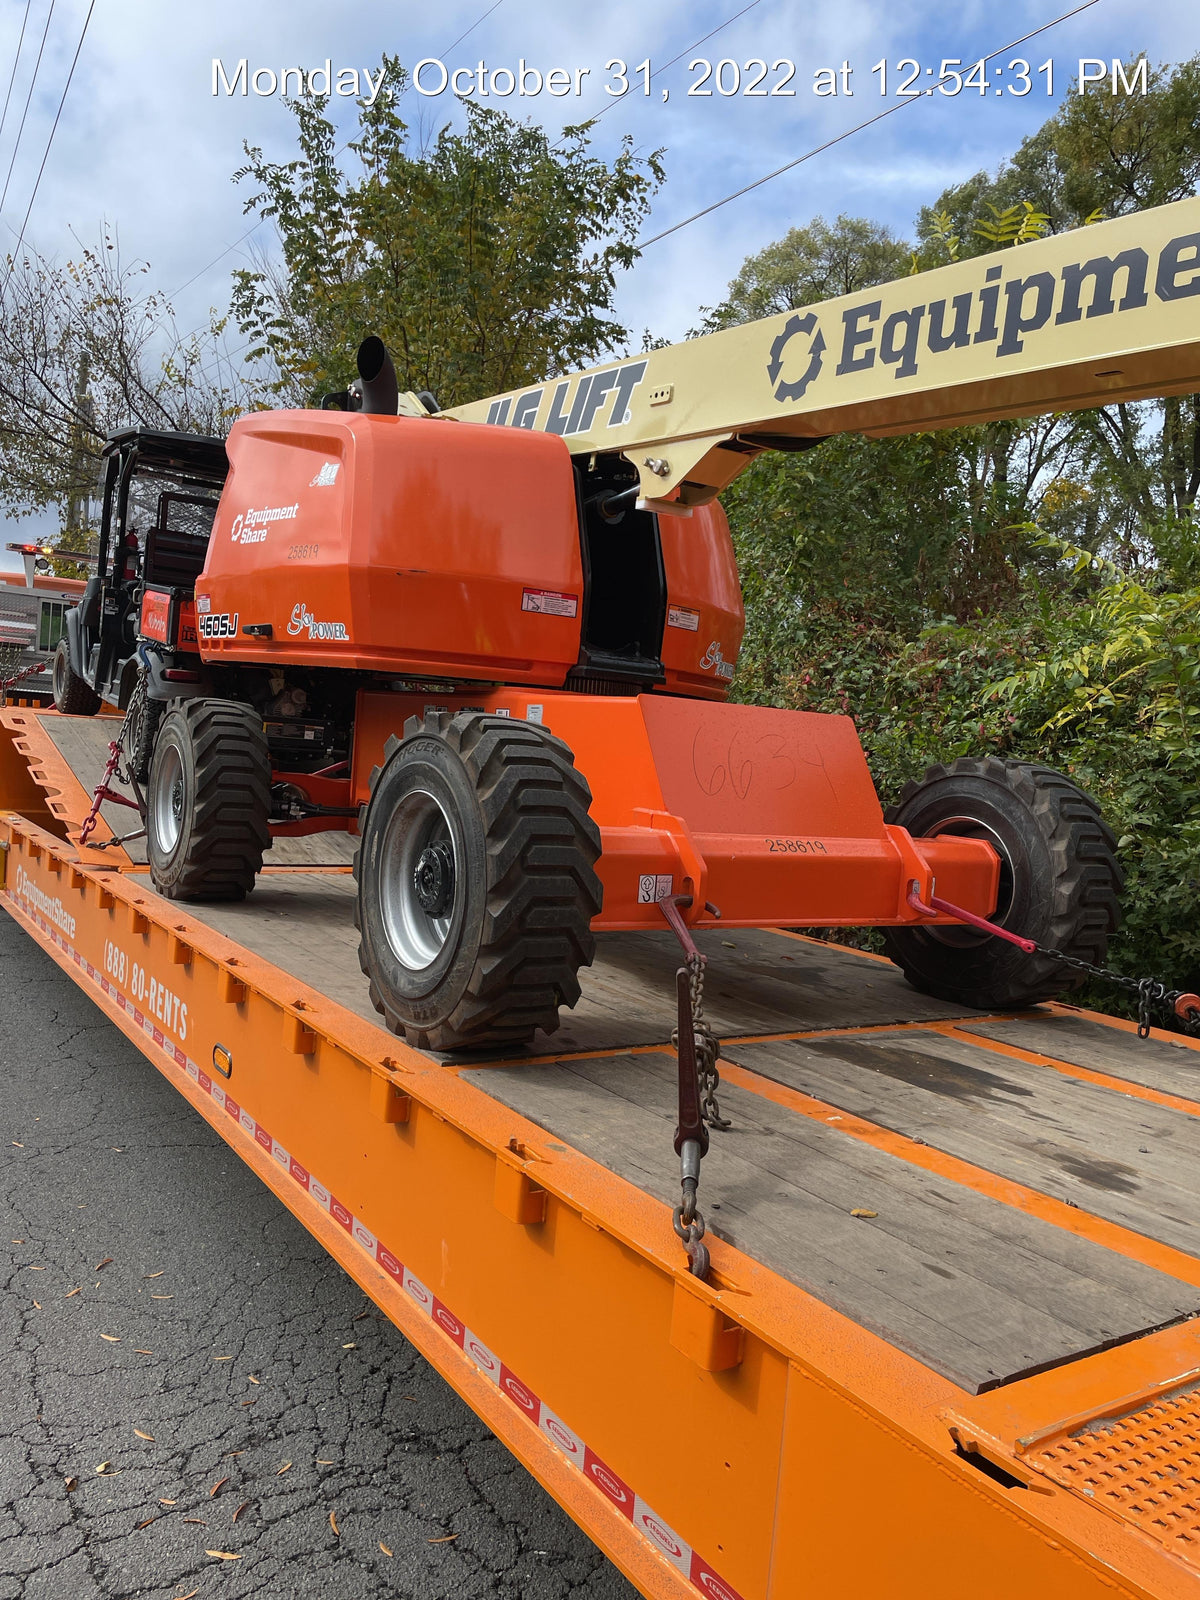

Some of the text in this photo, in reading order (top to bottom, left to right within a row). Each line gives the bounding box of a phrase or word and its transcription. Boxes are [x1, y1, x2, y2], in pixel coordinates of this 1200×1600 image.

[245, 503, 299, 527] Equipment
[240, 527, 268, 545] Share
[288, 544, 319, 560] 258619
[199, 612, 239, 638] 460SJ
[765, 838, 828, 854] 258619
[104, 938, 188, 1041] (888) 80-RENTS
[650, 1522, 675, 1550] LEDWELL
